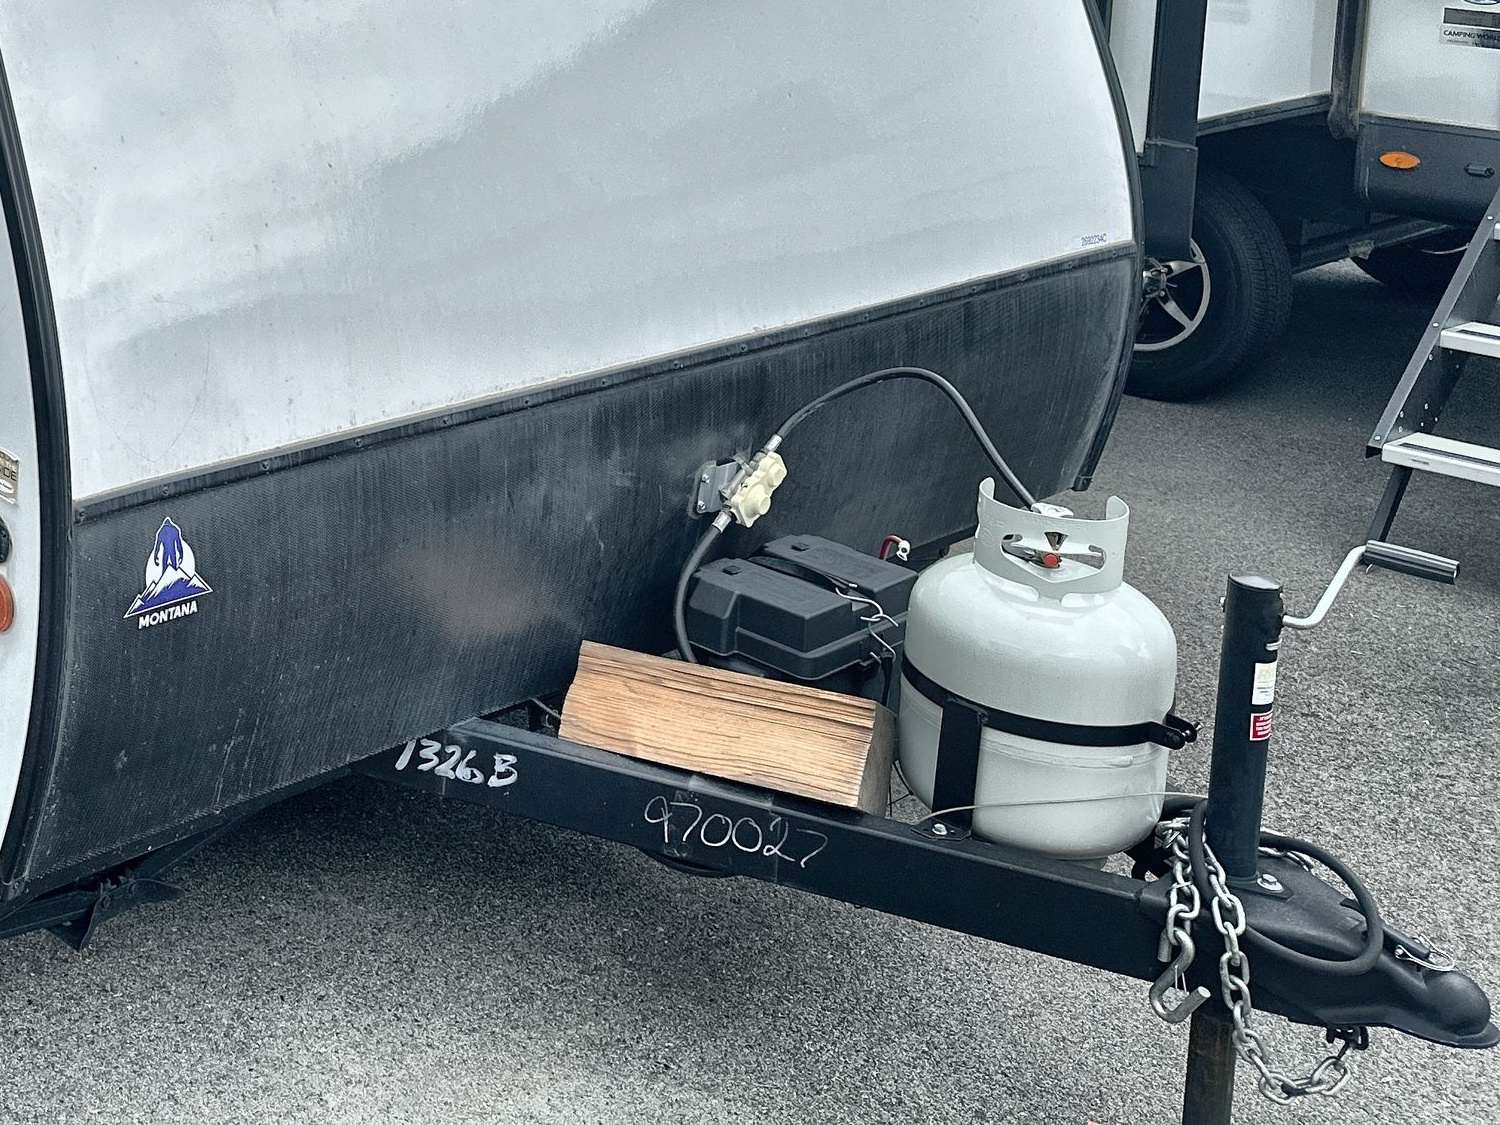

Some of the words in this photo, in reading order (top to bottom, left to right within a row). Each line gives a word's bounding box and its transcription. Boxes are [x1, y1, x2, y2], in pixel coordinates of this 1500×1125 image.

[1443, 29, 1475, 39] CAMPING
[138, 600, 198, 629] MONTANA
[644, 796, 828, 868] 970027
